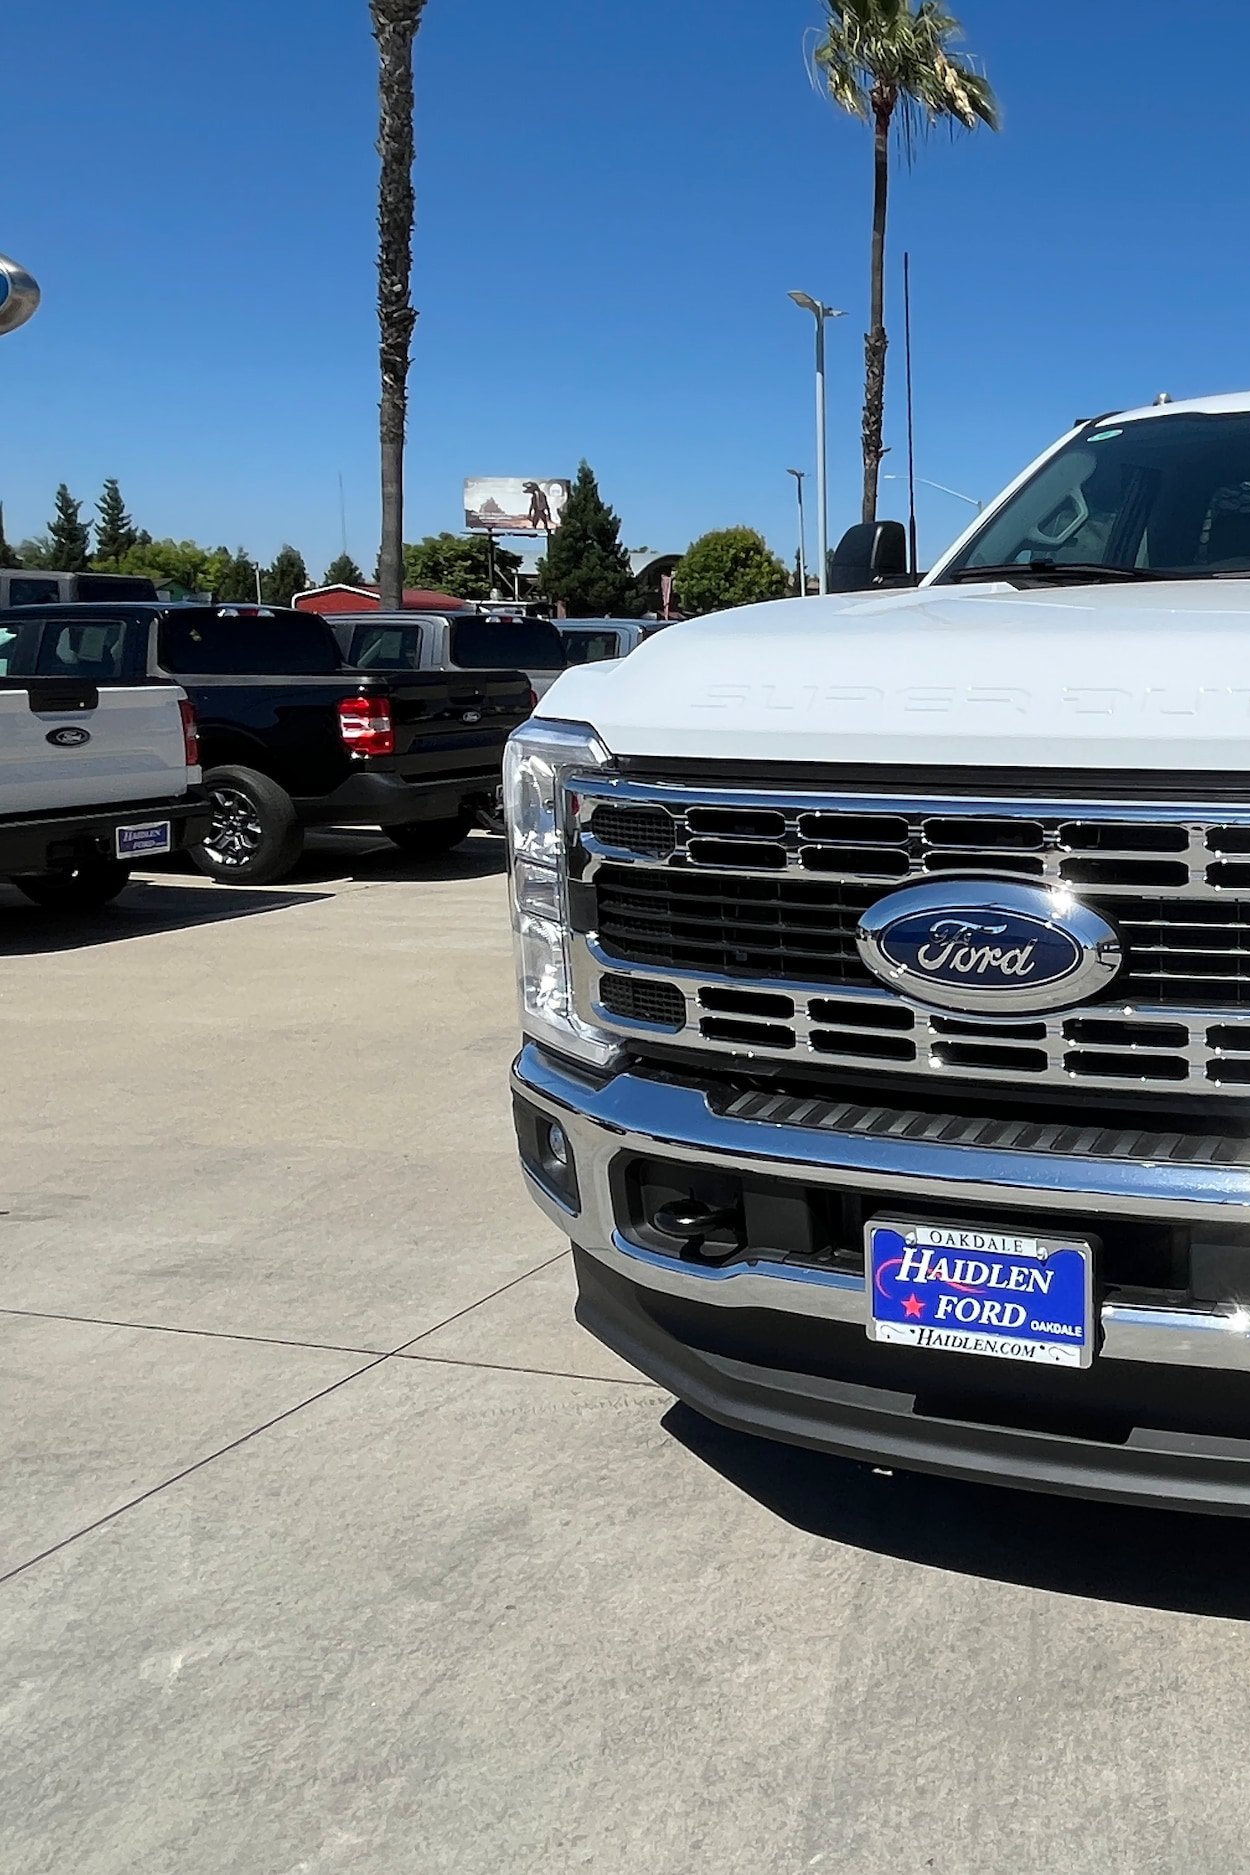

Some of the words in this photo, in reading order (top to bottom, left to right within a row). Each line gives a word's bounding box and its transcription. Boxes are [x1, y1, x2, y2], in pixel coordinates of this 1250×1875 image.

[690, 684, 1032, 716] SUPER
[917, 919, 1039, 977] Ford
[929, 1230, 1024, 1253] OAKDALE
[895, 1247, 1054, 1294] HAIDLEN
[934, 1294, 1027, 1328] FORD
[1031, 1320, 1083, 1338] OAKDALE
[916, 1328, 1036, 1358] HAIDLEN.COM
